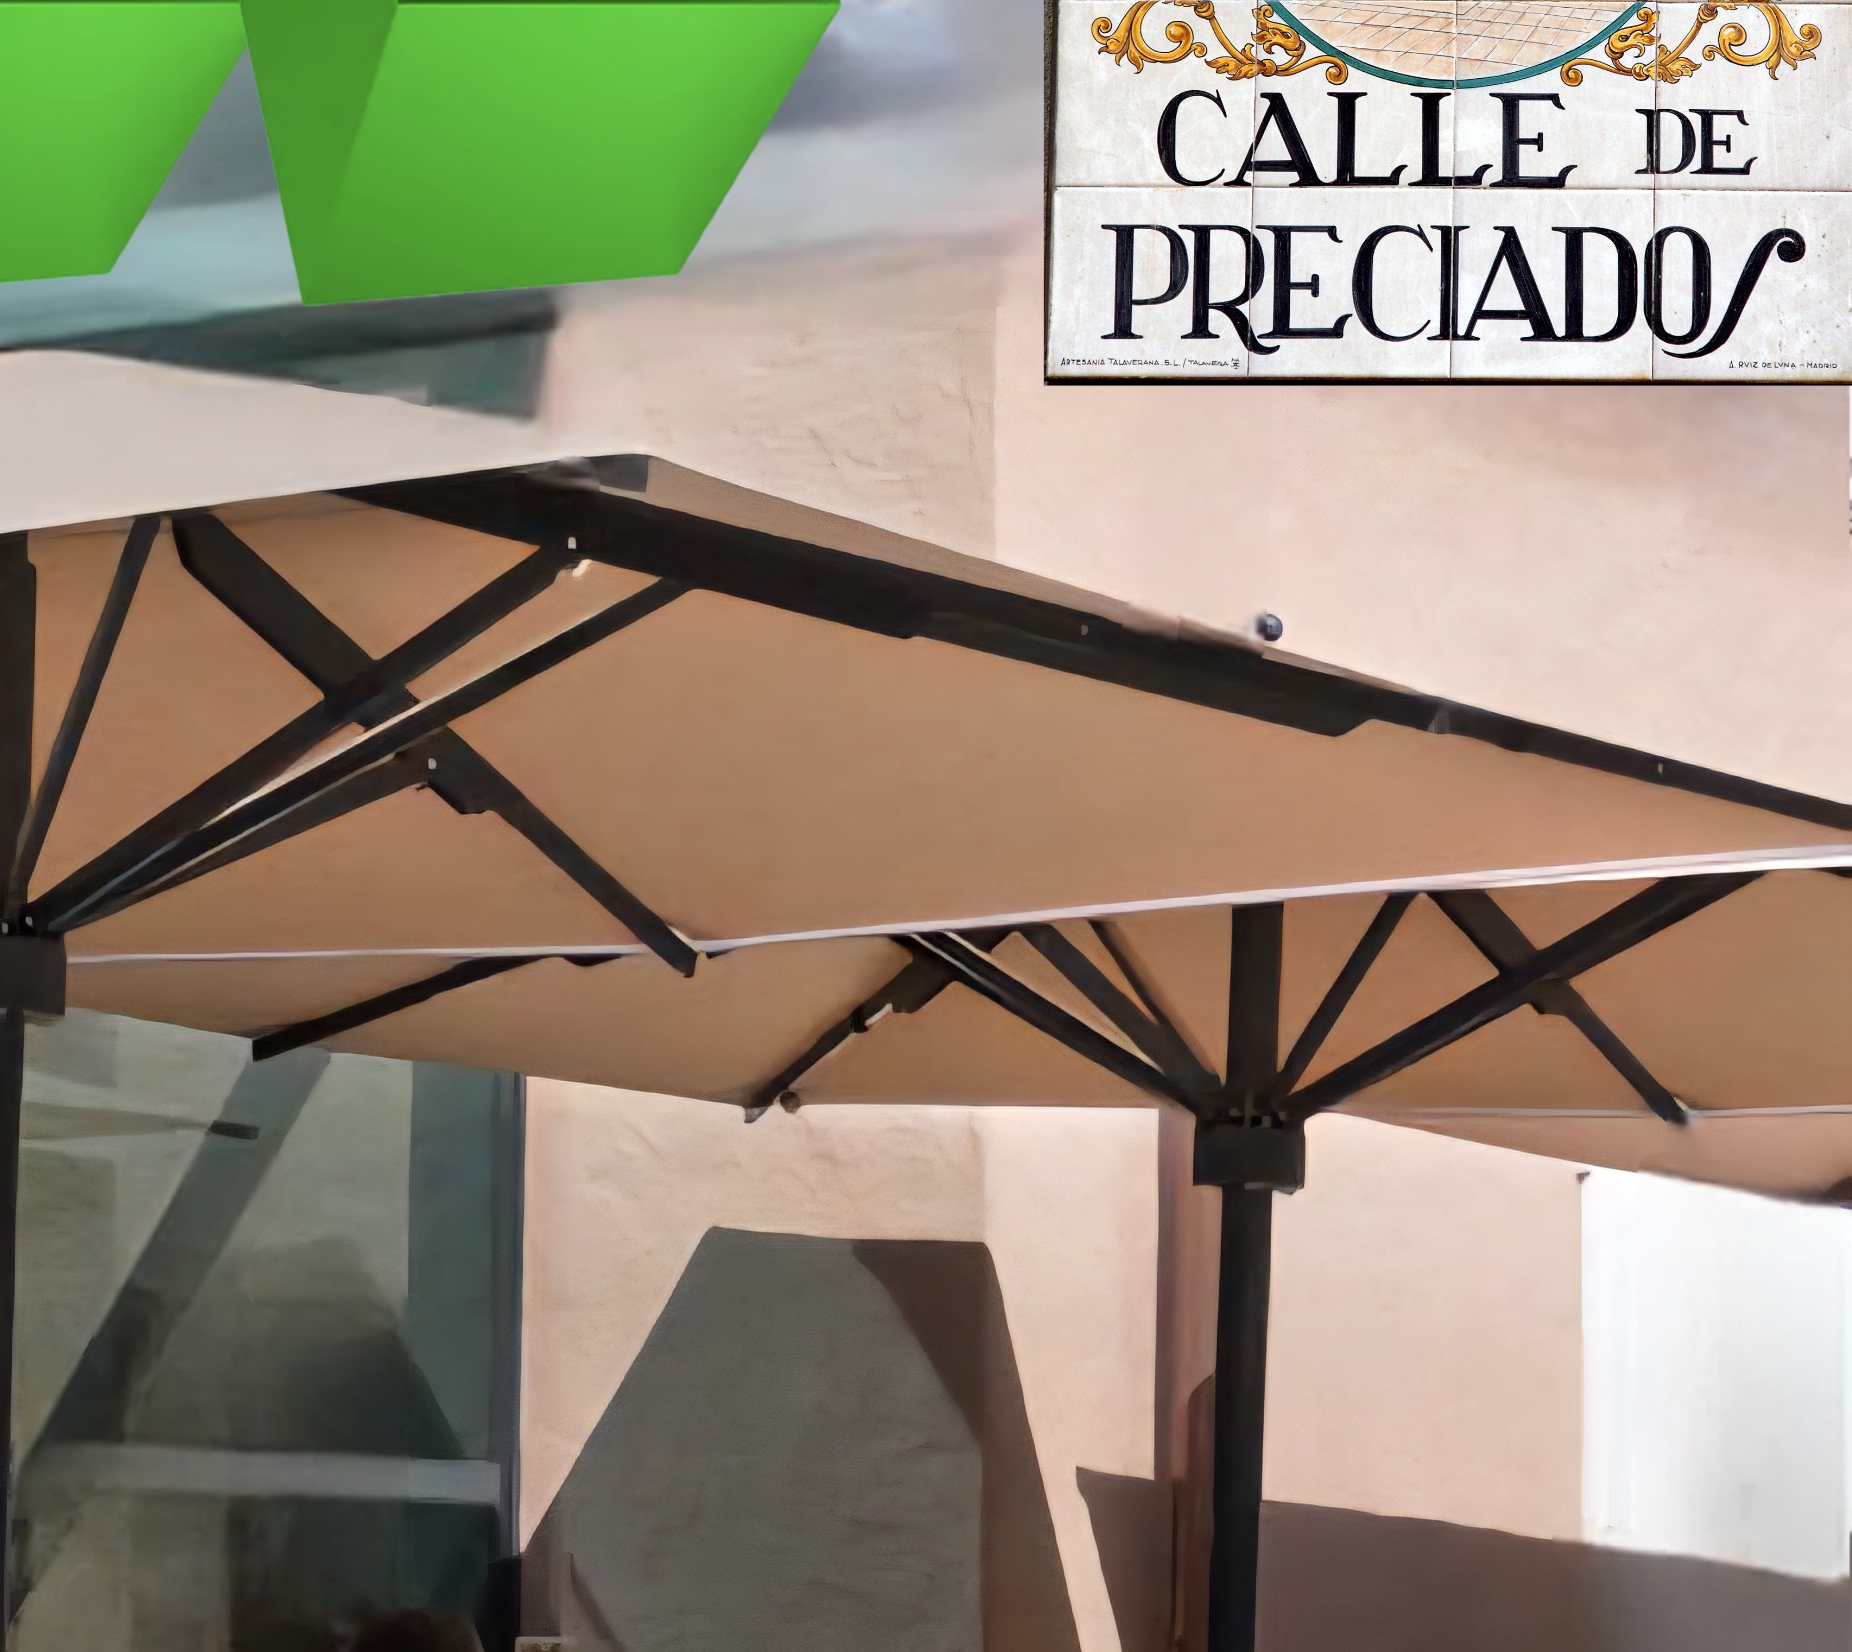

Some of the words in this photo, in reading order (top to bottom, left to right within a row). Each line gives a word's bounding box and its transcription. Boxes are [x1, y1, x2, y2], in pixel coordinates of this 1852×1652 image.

[1156, 89, 1578, 188] CALLE
[1634, 108, 1758, 175] DE
[1100, 223, 1807, 358] PRECIADOS
[1060, 357, 1106, 367] ARTESANIA
[1806, 361, 1838, 369] MADRID
